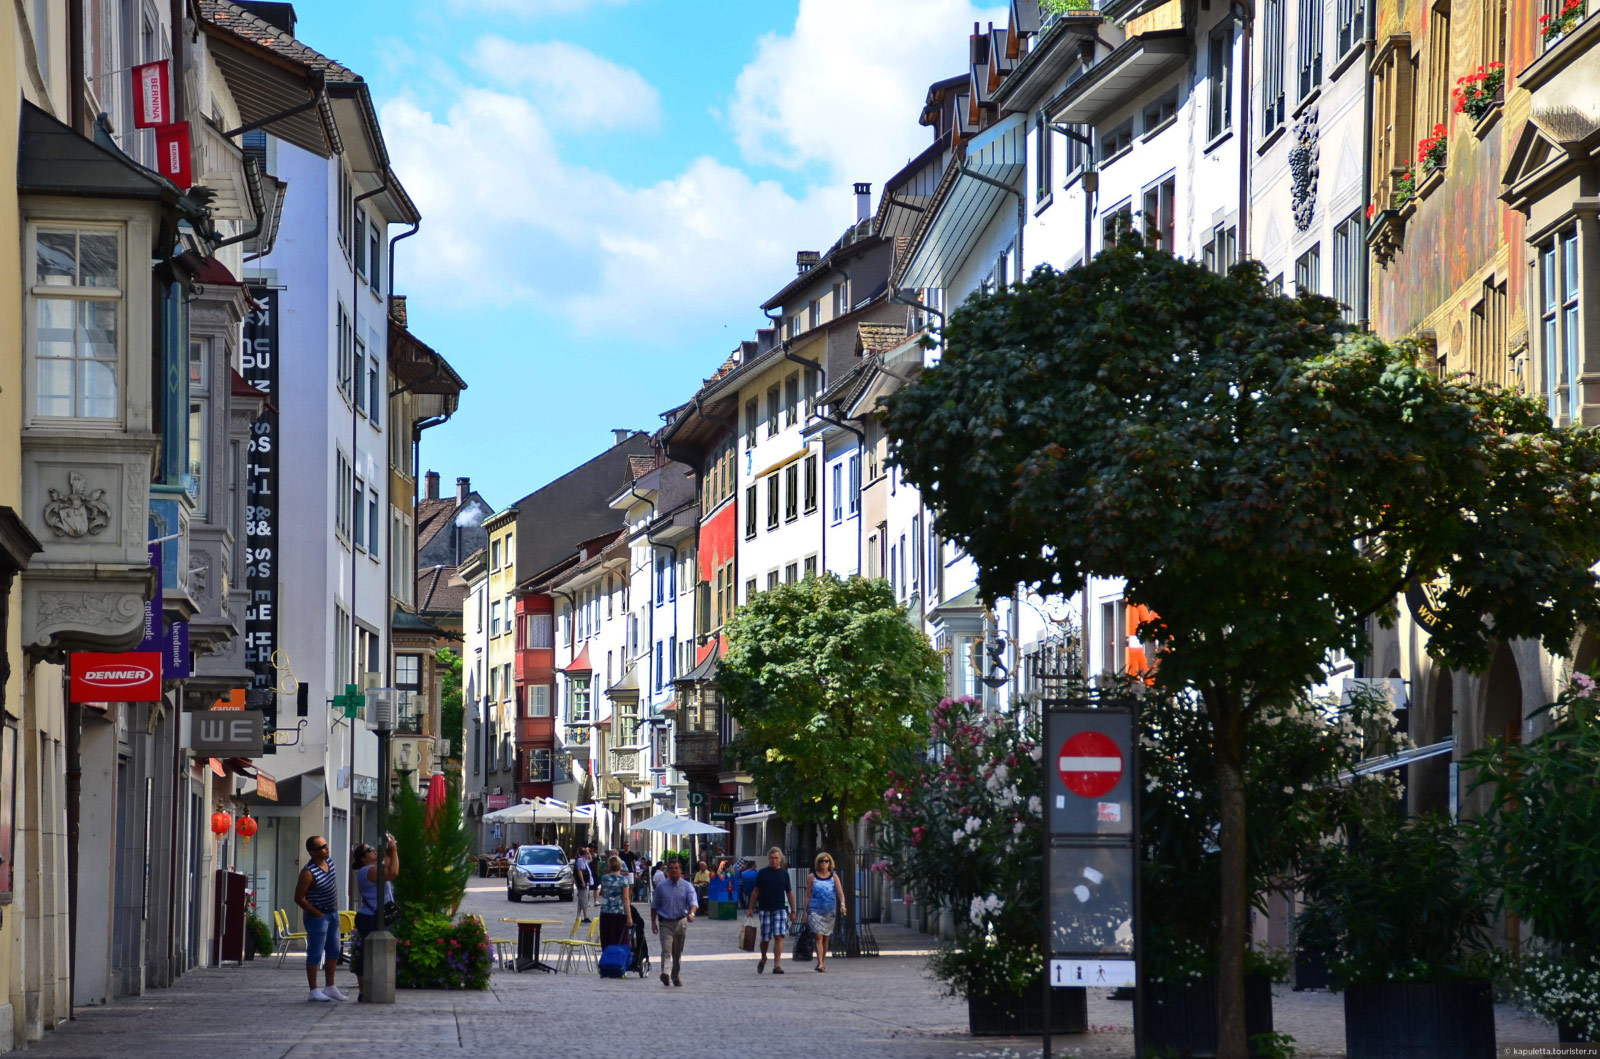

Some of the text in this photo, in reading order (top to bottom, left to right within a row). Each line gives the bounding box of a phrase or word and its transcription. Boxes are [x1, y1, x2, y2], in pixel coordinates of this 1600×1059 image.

[151, 77, 161, 119] BERNINA
[85, 670, 146, 680] DENNER
[200, 719, 254, 742] WE
